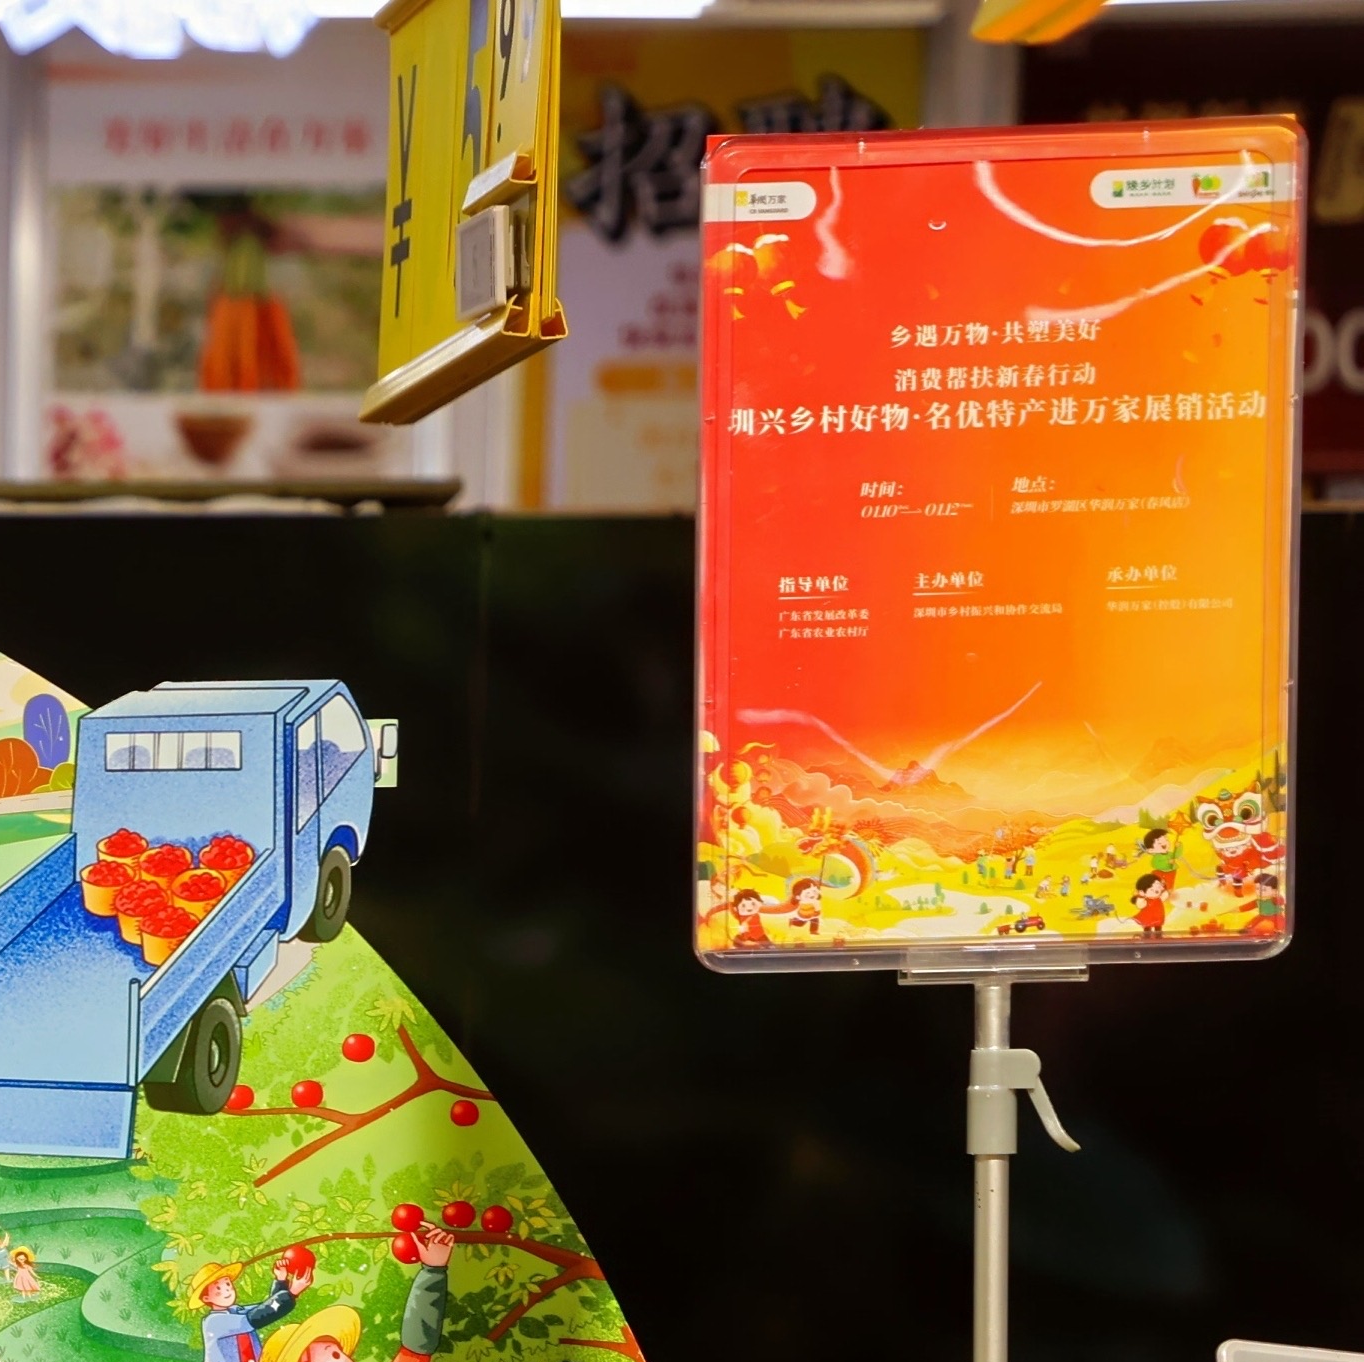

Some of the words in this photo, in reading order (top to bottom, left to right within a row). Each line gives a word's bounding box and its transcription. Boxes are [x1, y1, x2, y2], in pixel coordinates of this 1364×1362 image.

[889, 319, 1102, 349] 乡遇万物·共塑美好
[894, 362, 1097, 393] 消费帮扶新春行动
[728, 390, 1267, 437] 圳兴乡村好物·名优特产进万家展销活动
[914, 571, 984, 590] 主办单位
[1106, 564, 1178, 583] 承办单位
[778, 575, 849, 594] 指导单位
[778, 608, 870, 622] 广东省发展改革委
[778, 626, 869, 640] 广东省农业农村厅
